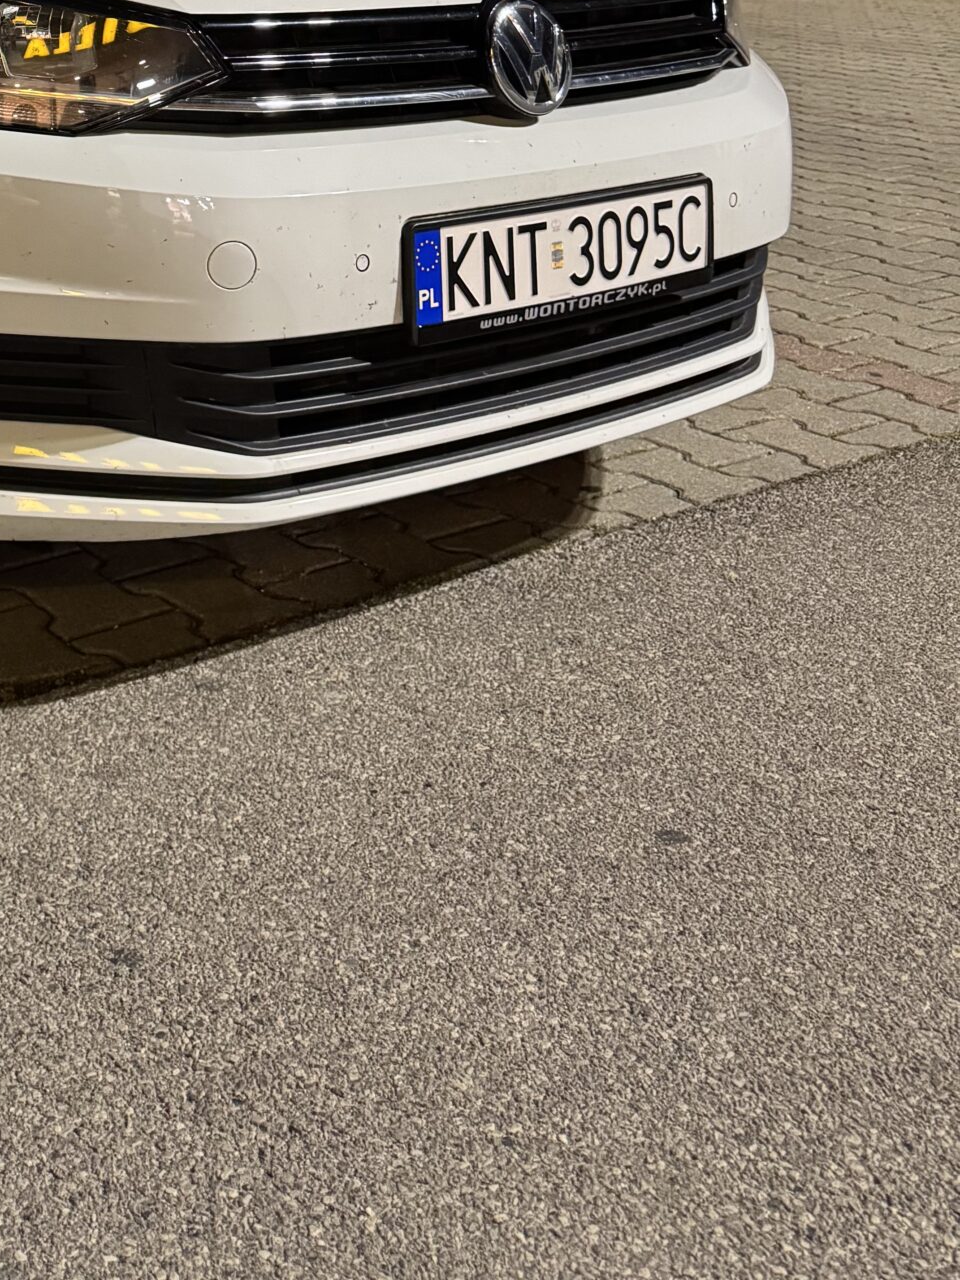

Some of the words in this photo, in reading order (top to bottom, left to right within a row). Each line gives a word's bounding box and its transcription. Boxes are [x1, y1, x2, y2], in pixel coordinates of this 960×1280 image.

[447, 221, 547, 312] KNT
[568, 195, 702, 287] 3095C
[418, 287, 440, 311] PL
